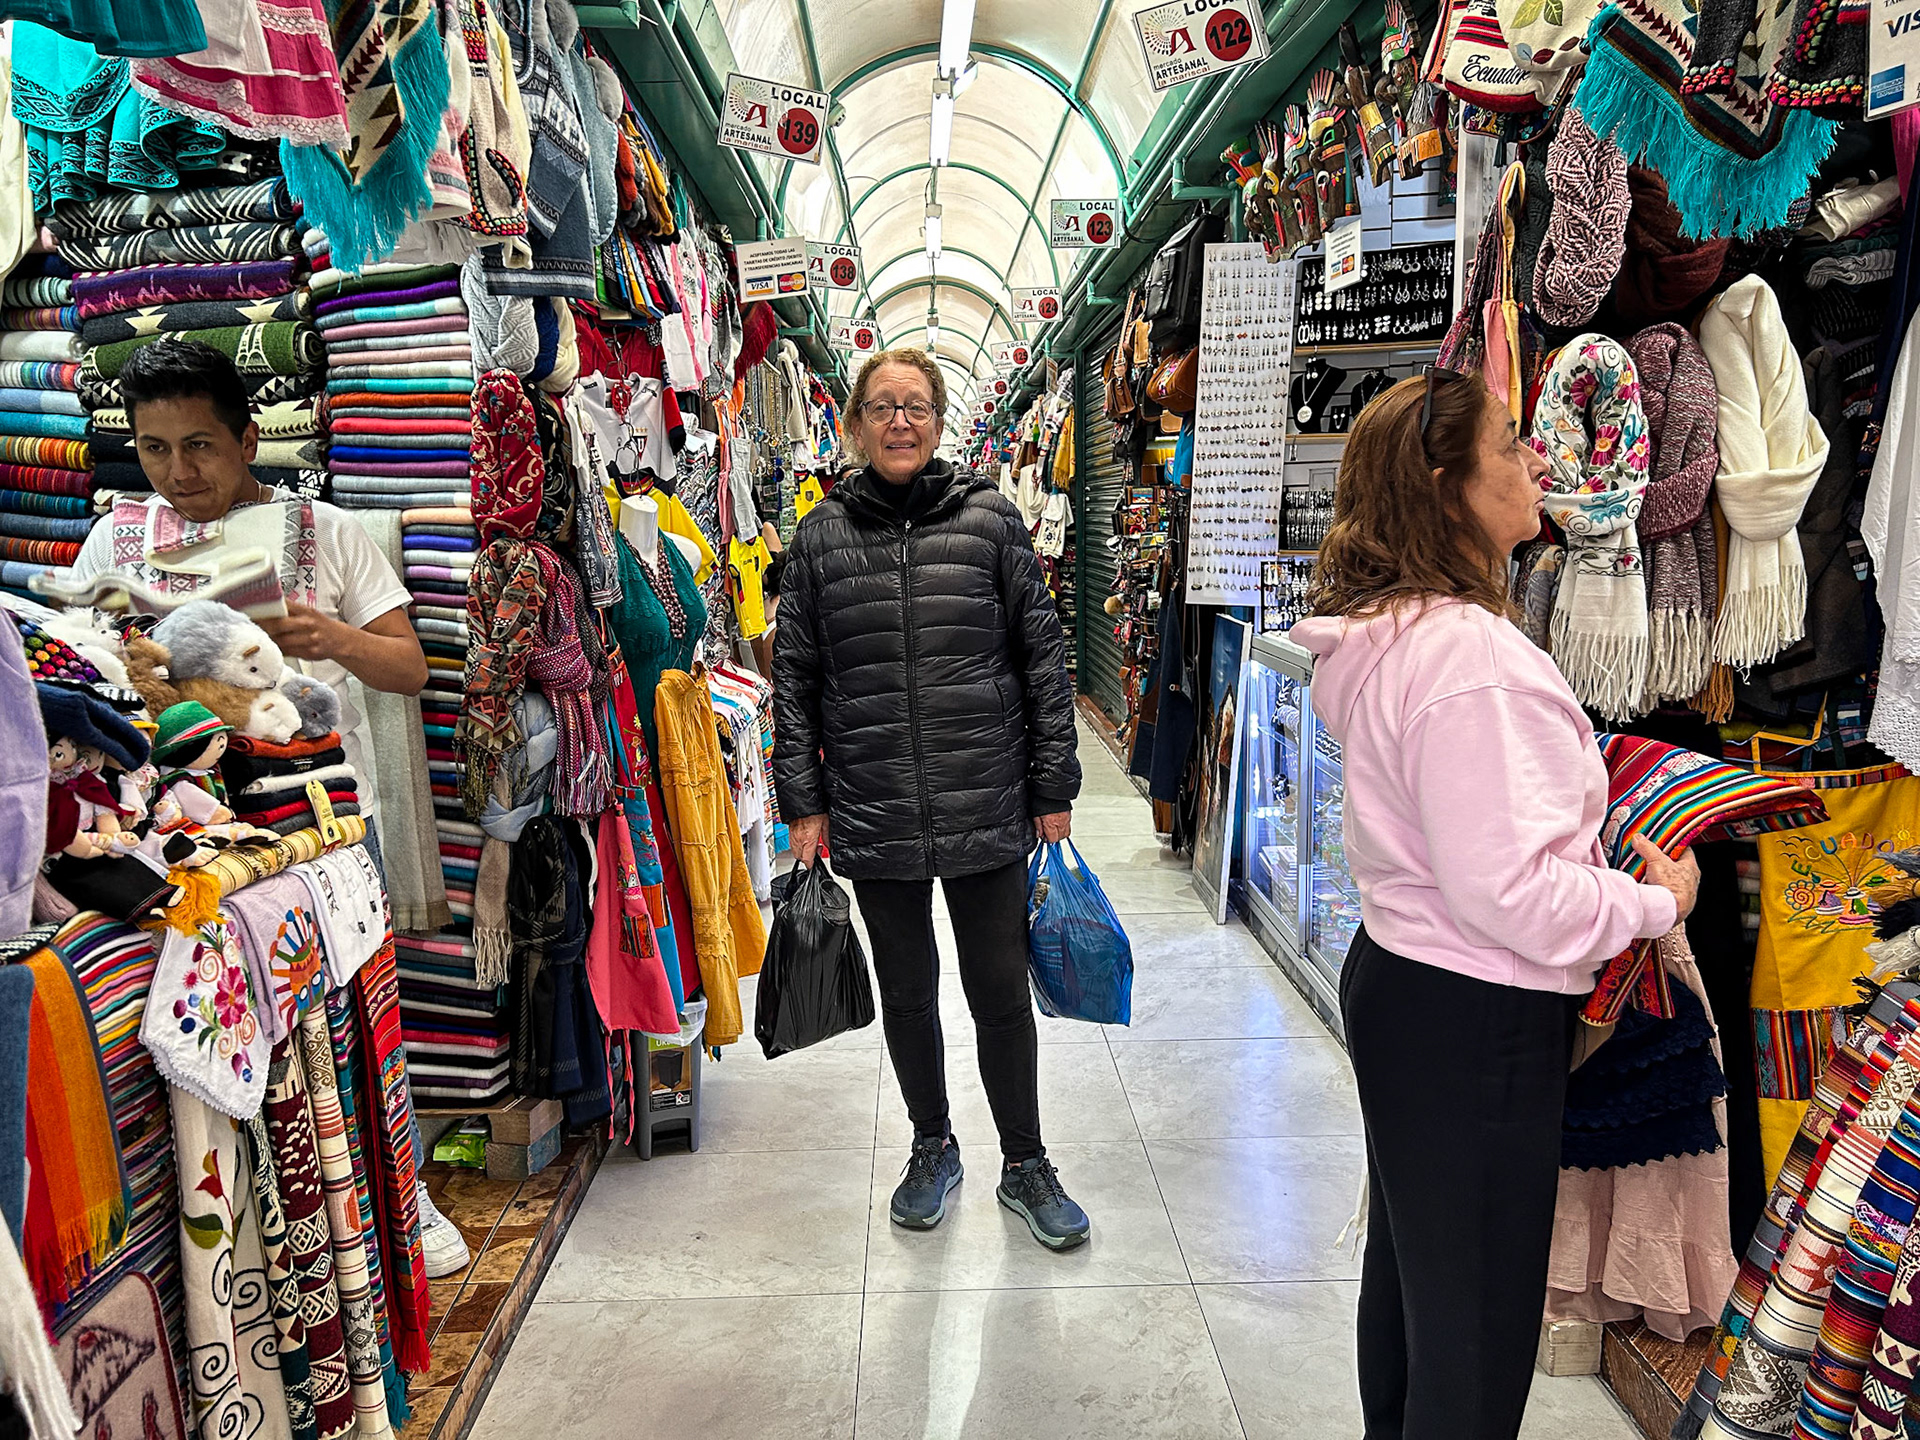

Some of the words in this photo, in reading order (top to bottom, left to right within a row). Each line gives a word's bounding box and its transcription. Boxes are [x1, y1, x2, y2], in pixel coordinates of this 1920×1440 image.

[1883, 8, 1920, 38] VIS
[1209, 17, 1250, 50] 122
[1153, 57, 1182, 70] mercado
[1155, 56, 1208, 80] ARTESANAL
[1462, 54, 1530, 85] Ecuador
[1157, 79, 1167, 88] la
[1170, 65, 1211, 84] mariscal
[770, 86, 825, 110] LOCAL
[725, 121, 752, 133] mercado
[782, 118, 817, 146] 139
[723, 128, 772, 146] ARTESANAL
[733, 138, 772, 151] mariscal
[1080, 202, 1115, 211] LOCAL
[1089, 220, 1112, 236] 123
[824, 245, 859, 257] LOCAL
[832, 265, 854, 280] 138
[751, 280, 769, 290] VISA
[1040, 302, 1057, 314] 124
[850, 320, 876, 329] LOCAL
[856, 333, 873, 345] 137
[1006, 341, 1029, 349] LOCAL
[1791, 831, 1895, 877] ECUADO
